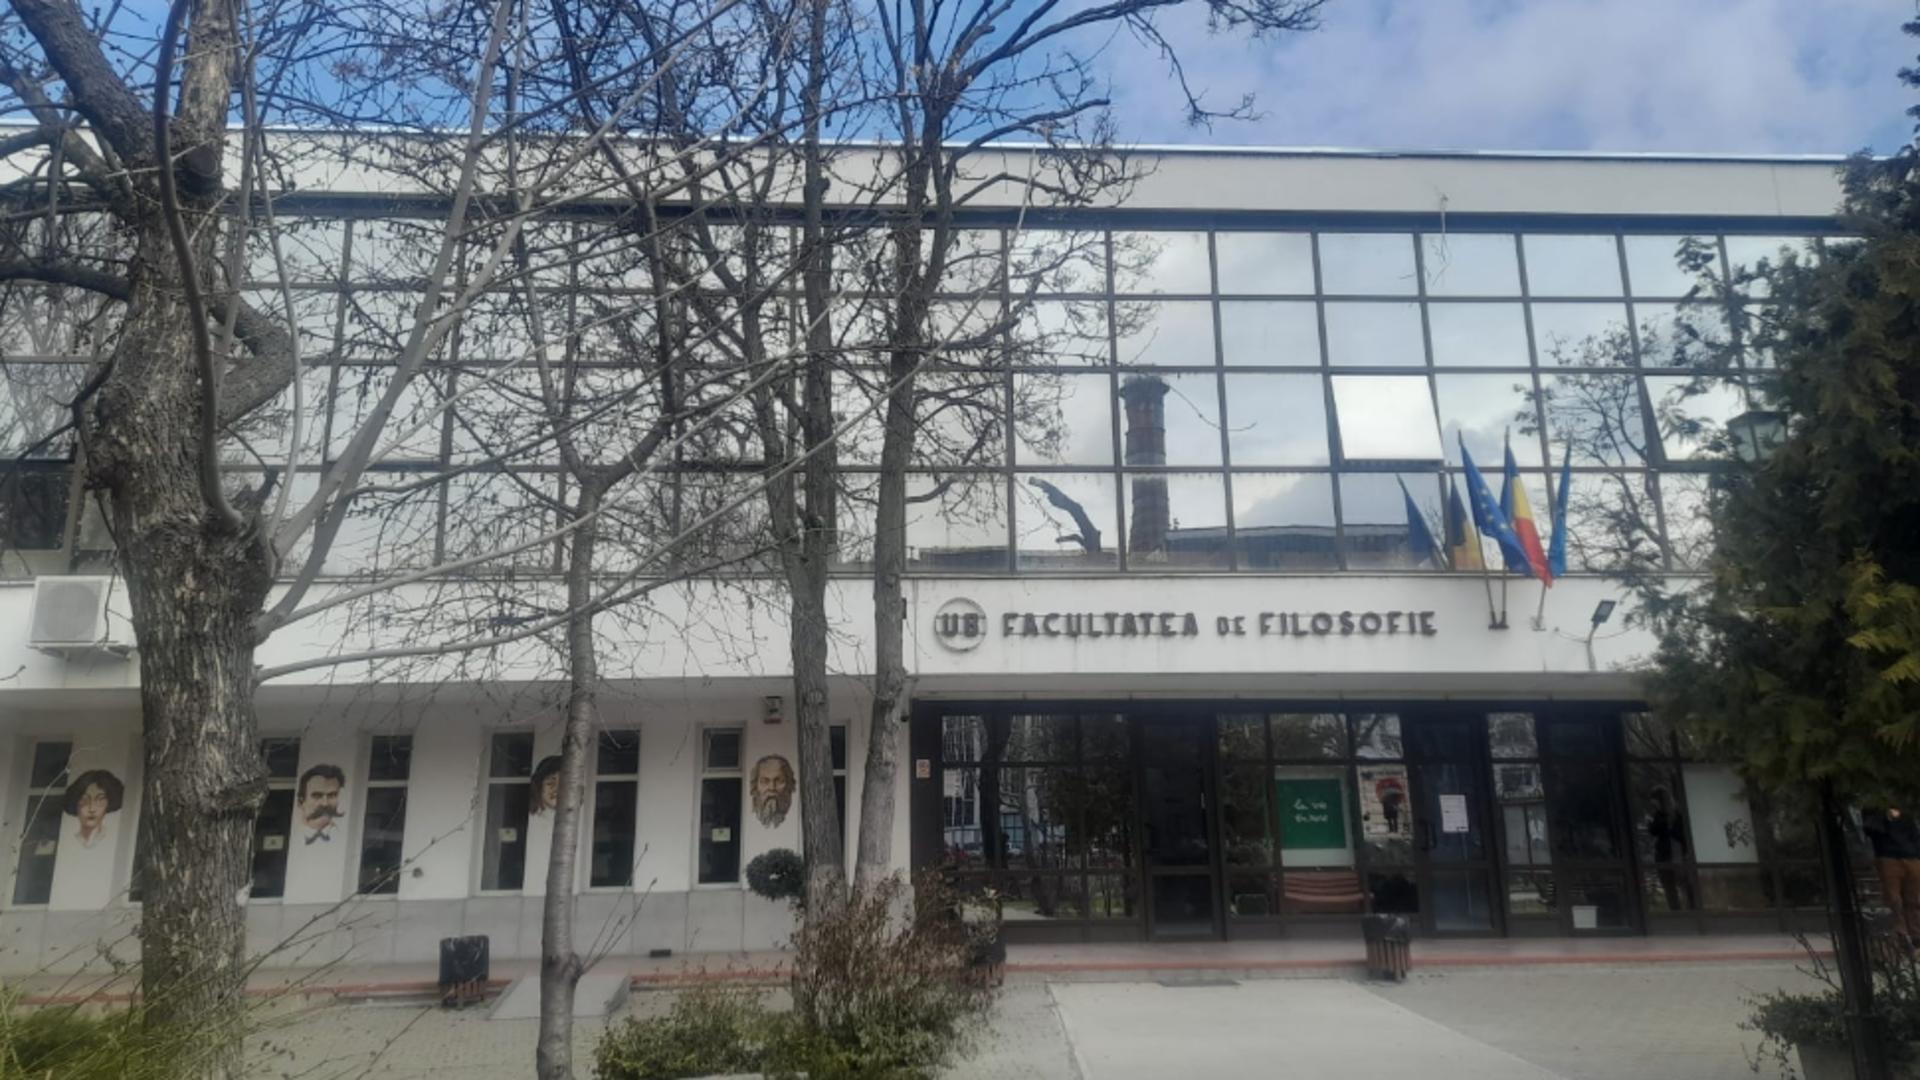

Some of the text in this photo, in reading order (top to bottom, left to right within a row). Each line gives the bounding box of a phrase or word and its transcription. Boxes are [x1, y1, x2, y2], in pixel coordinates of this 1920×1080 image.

[942, 612, 979, 638] UB
[1002, 611, 1437, 638] FACULTATEA DE FILOSOFIE
